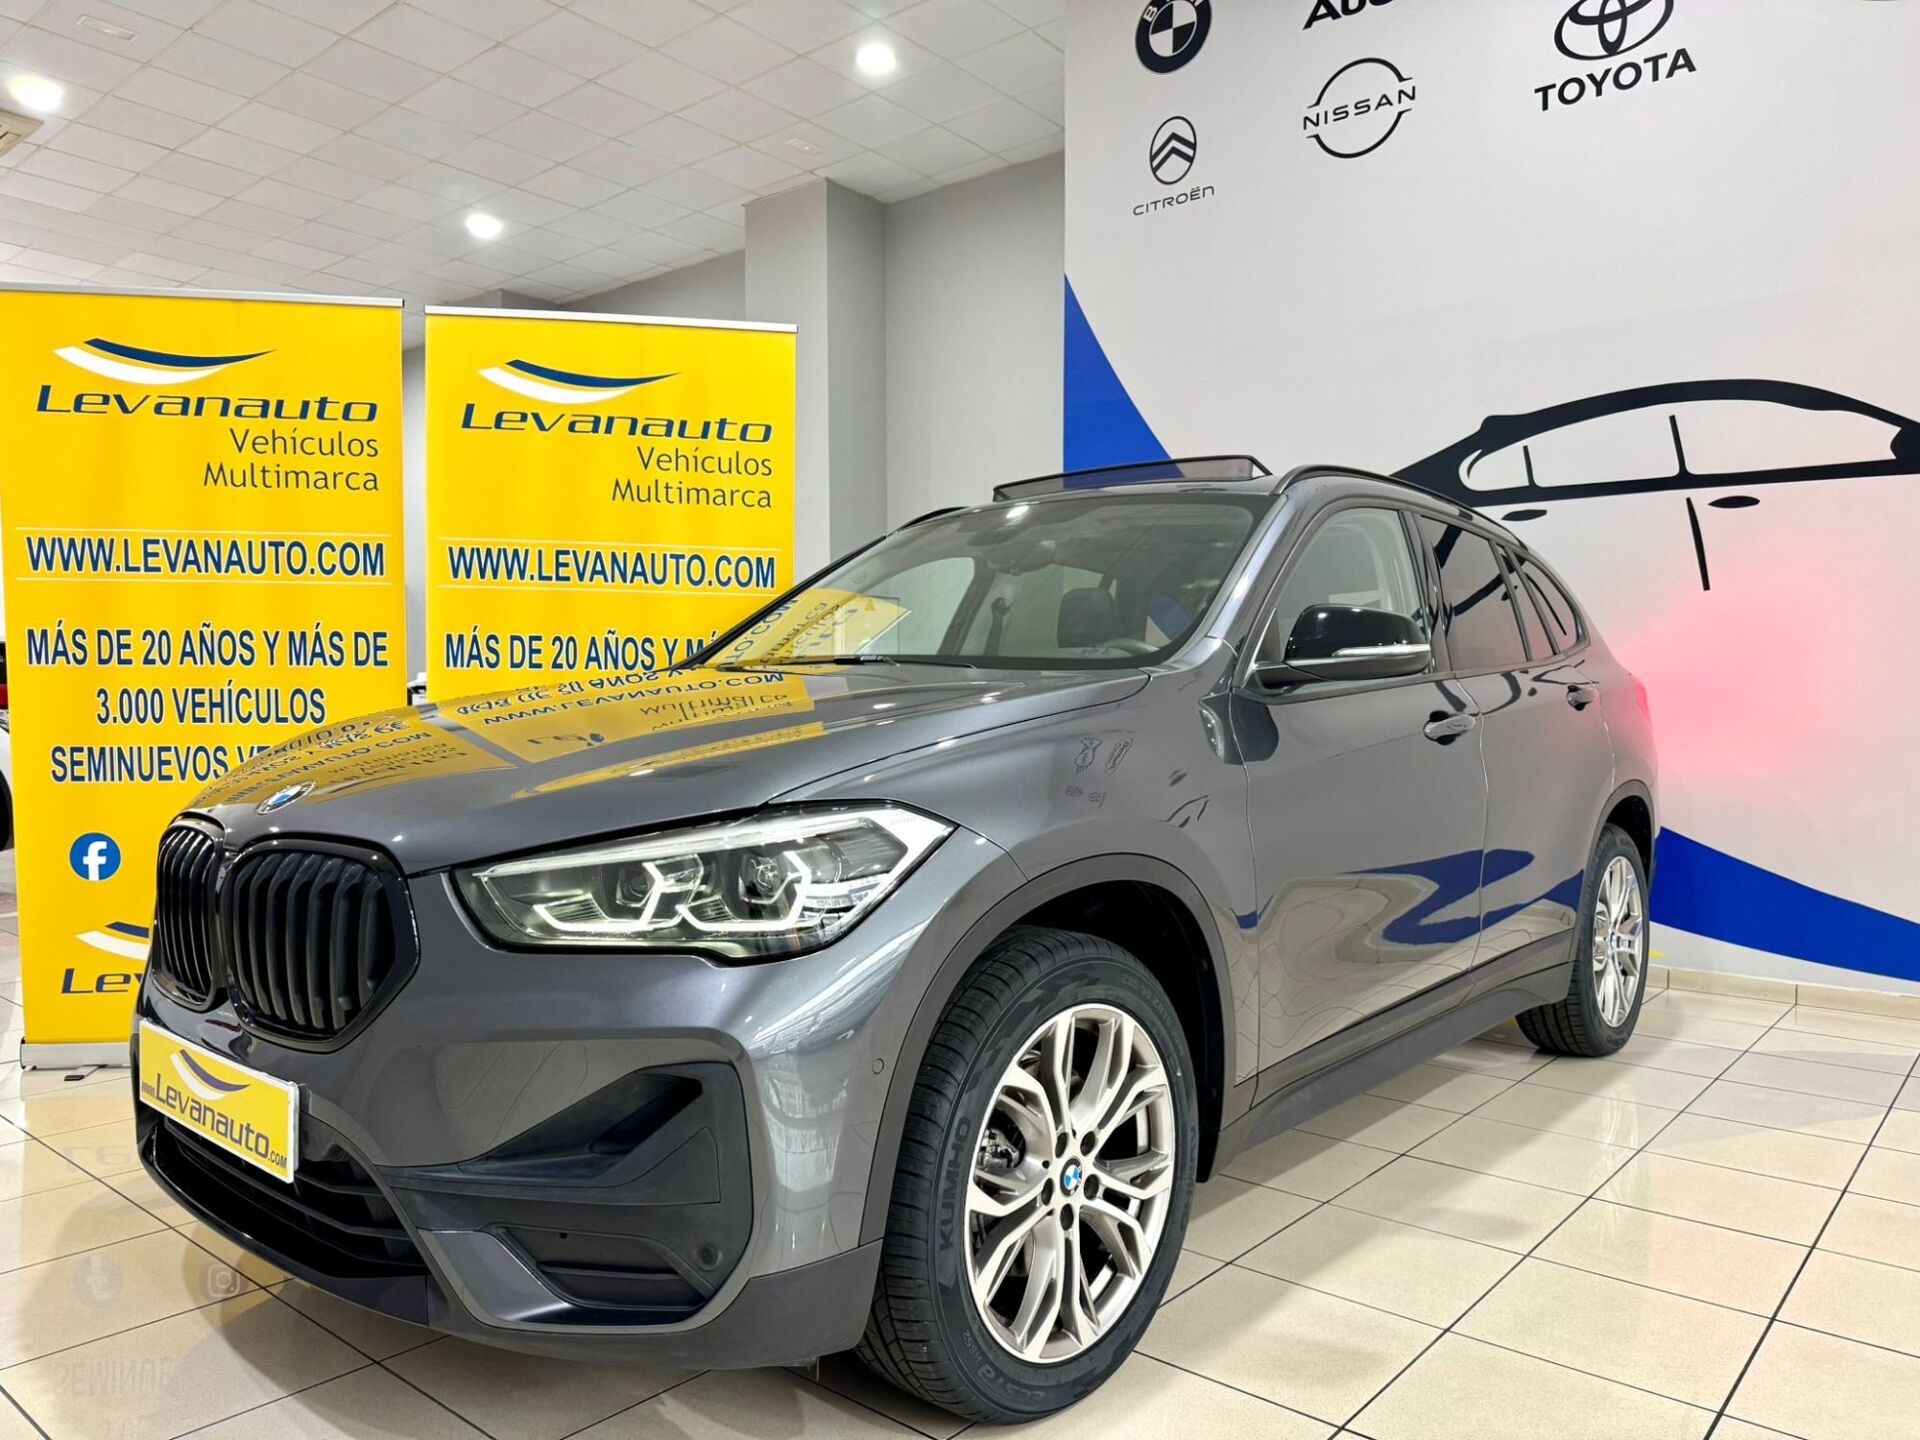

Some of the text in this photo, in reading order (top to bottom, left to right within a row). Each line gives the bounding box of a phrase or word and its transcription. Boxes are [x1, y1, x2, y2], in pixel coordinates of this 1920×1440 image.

[1534, 47, 1696, 112] TOYOTA
[1303, 85, 1416, 131] NISSAN
[36, 384, 379, 423] Levanauto
[461, 403, 773, 443] Levanauto
[229, 427, 380, 458] Vehículos
[636, 446, 773, 477] Vehículos
[203, 462, 380, 491] Multimarca
[611, 479, 773, 508] Multimarca
[26, 536, 385, 577] WWW.LEVANAUTO.COM
[448, 546, 776, 589] WWW.LEVANAUTO.COM
[27, 621, 388, 667] MÁS DE 20 AÑOS Y MÁS DE
[445, 625, 500, 669] MÁS
[509, 634, 543, 670] DE
[551, 636, 577, 670] 20
[585, 630, 656, 672] AÑOS
[663, 638, 679, 669] Y
[96, 680, 326, 725] 3.000 VEHÍCULOS
[51, 746, 228, 782] SEMINUEVOS
[939, 1116, 972, 1251] KUMHO
